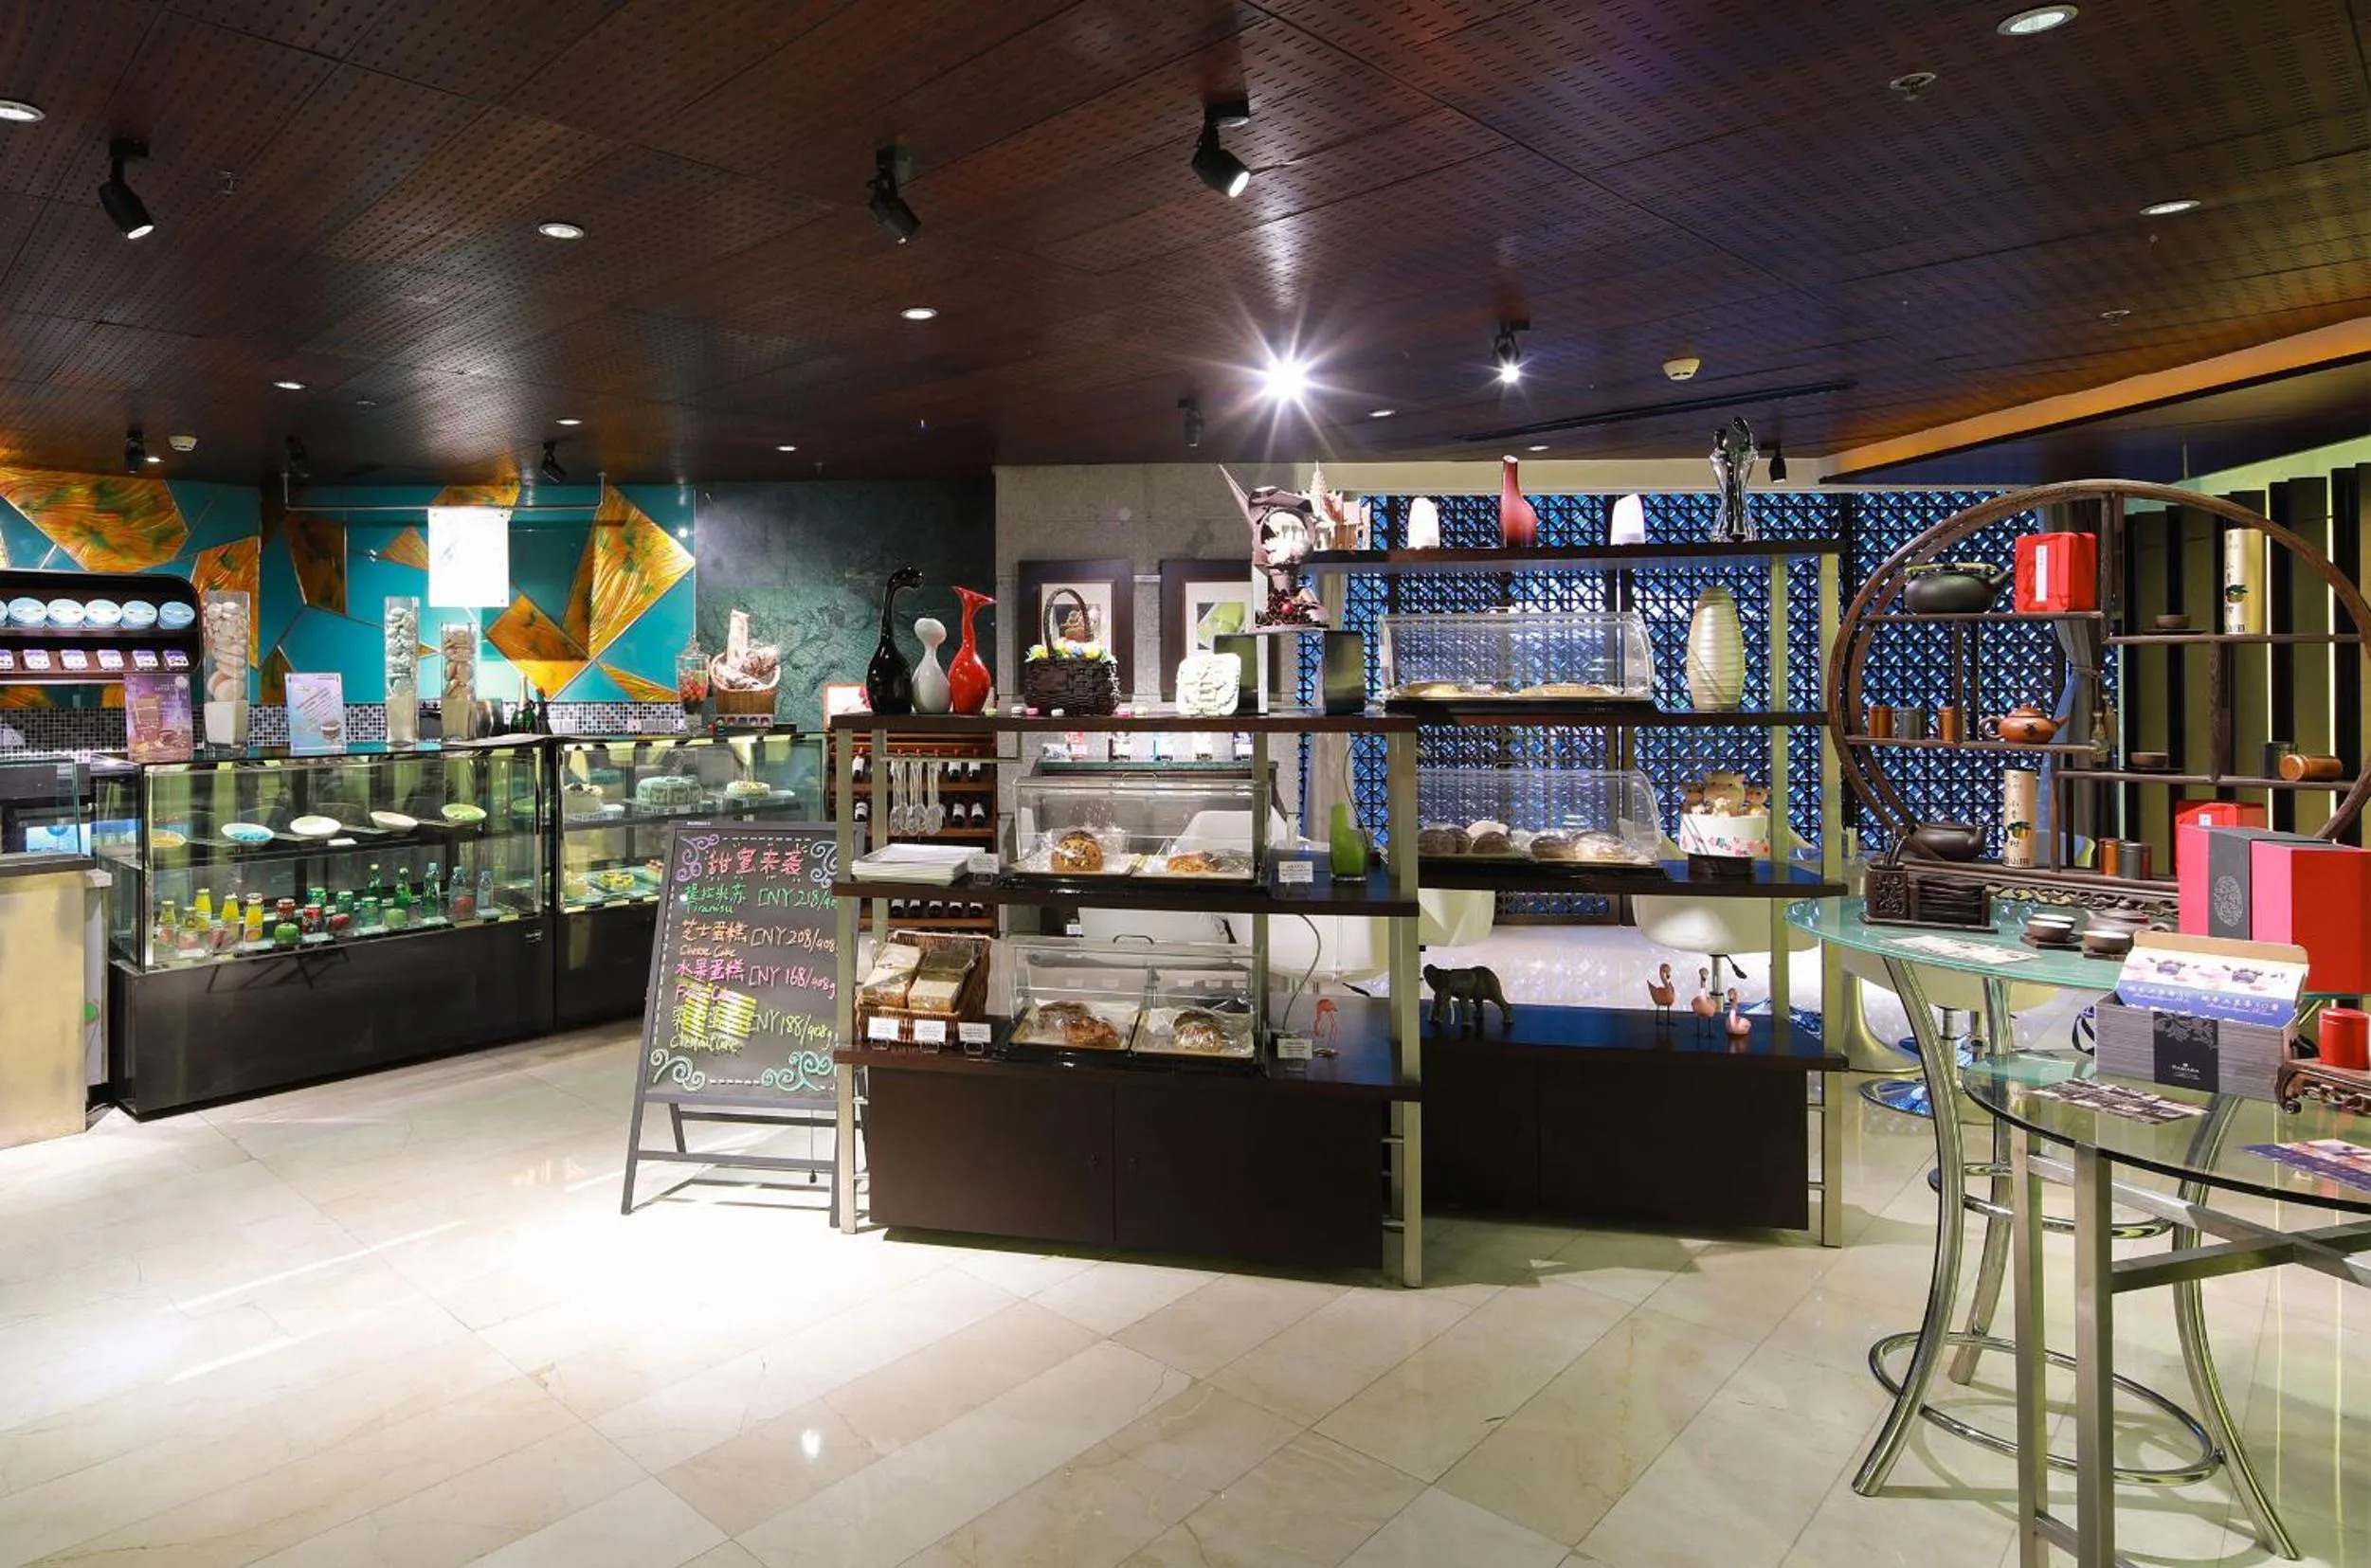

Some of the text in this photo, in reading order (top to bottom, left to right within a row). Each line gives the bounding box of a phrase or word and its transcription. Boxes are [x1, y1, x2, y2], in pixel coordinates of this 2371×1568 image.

[758, 888, 794, 907] CNY
[682, 918, 839, 956] 芝士蛋糕 CNY 208/908
[675, 959, 745, 982] 水果蛋糕
[749, 965, 780, 987] CNY
